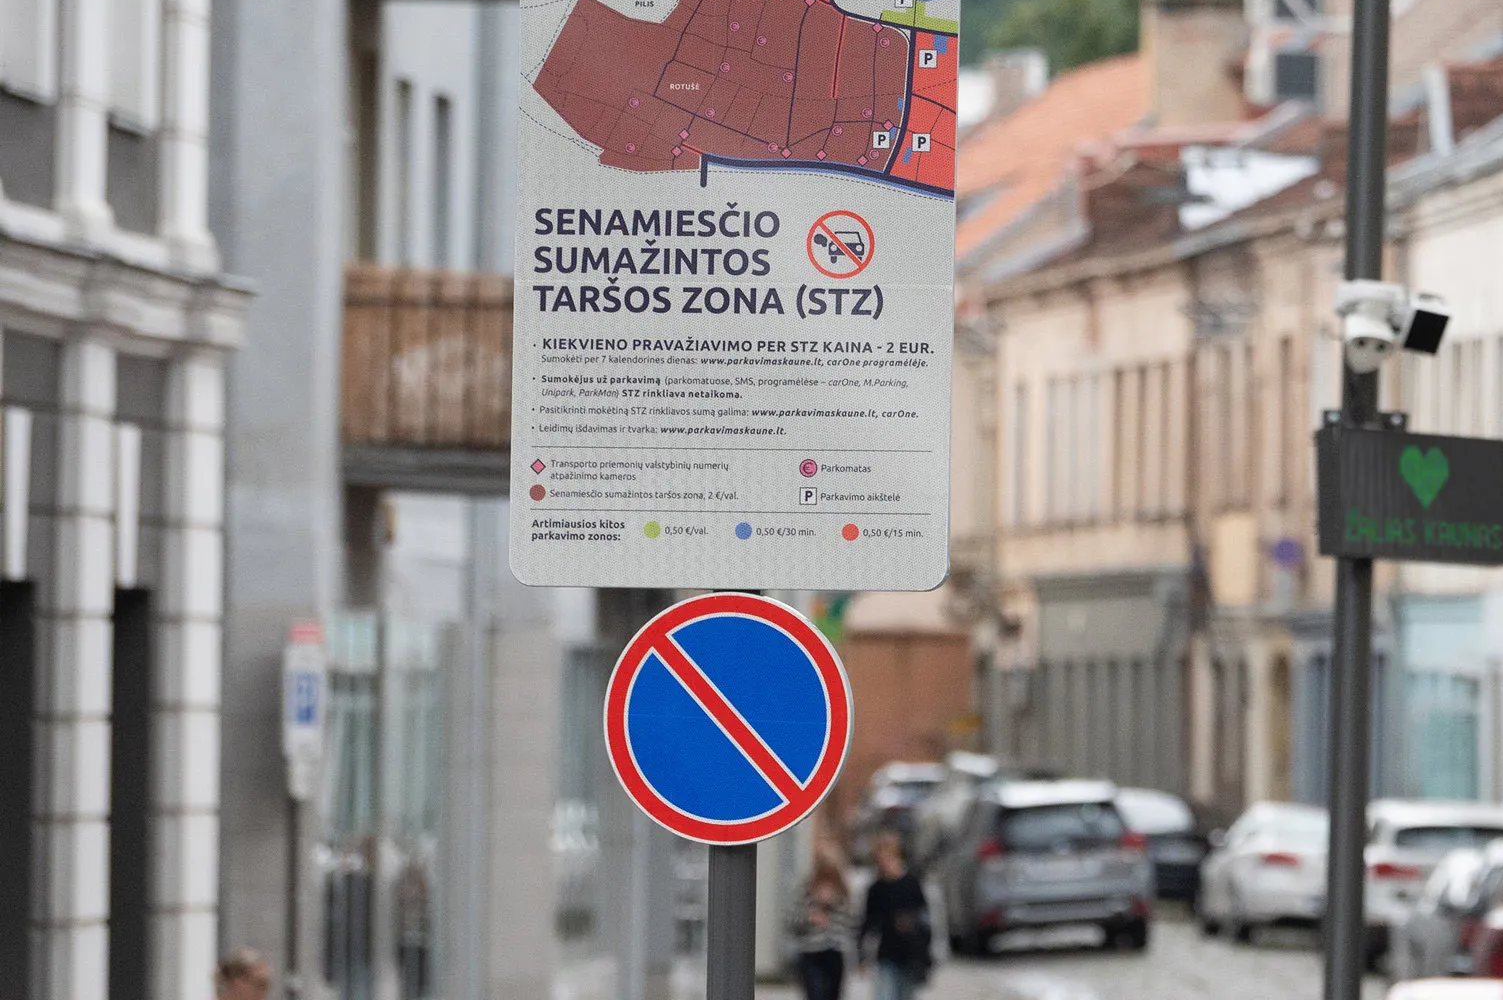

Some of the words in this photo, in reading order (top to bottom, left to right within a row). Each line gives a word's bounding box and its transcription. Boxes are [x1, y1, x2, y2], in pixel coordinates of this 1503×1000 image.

[534, 202, 780, 238] SENAMIESČIO
[533, 239, 771, 277] SUMAŽINTOS
[533, 277, 672, 314] TARŠOS
[681, 286, 785, 315] ZONA
[795, 284, 884, 320] (STZ)
[542, 338, 628, 350] KIEKVIENO
[632, 336, 752, 352] PRAVAŽIAVIMO
[757, 340, 786, 352] PER
[790, 340, 818, 353] STZ
[823, 341, 872, 353] KAINA
[886, 342, 894, 353] 2
[899, 342, 935, 354] EUR.
[541, 354, 583, 363] Sumokėti
[584, 356, 599, 364] per
[602, 355, 607, 363] 7
[608, 355, 665, 364] kalendorines
[666, 356, 698, 365] dienas:
[700, 356, 825, 368] www.parkavimaskaune.lt,
[826, 358, 861, 366] carOne
[862, 358, 929, 368] programėlėje.
[541, 374, 594, 385] Sumokėjus
[596, 374, 608, 384] už
[609, 375, 661, 386] parkavimą
[664, 376, 734, 387] (parkomatuose,
[734, 377, 757, 387] SMS,
[757, 377, 819, 388] programėlėse
[828, 378, 861, 388] carOne,
[578, 388, 619, 397] ParkMan)
[621, 389, 640, 397] STZ
[642, 389, 686, 398] rinkliava
[688, 389, 743, 399] netaikoma.
[539, 405, 586, 414] Pasitikrinti
[588, 406, 629, 416] mokėtiną
[630, 406, 647, 415] STZ
[648, 407, 691, 416] rinkliavos
[692, 409, 716, 417] sumą
[717, 408, 750, 418] galima:
[751, 408, 879, 420] www.parkavimaskaune.lt,
[881, 409, 919, 418] carOne.
[538, 424, 573, 433] Leidimų
[575, 424, 617, 433] išdavimas
[620, 425, 626, 433] ir
[627, 425, 658, 433] tvarka:
[660, 425, 787, 436] www.parkavimaskaune.lt.
[551, 459, 598, 469] Transporto
[599, 461, 643, 470] priemonių
[644, 460, 691, 471] valstybinių
[693, 462, 729, 471] numerių
[821, 464, 872, 473] Parkomatas
[550, 471, 598, 481] atpažinimo
[599, 472, 637, 481] kameros
[550, 489, 603, 498] Senamiesčio
[604, 490, 653, 499] sumažintos
[654, 490, 682, 499] taršos
[707, 491, 713, 500] 2
[715, 491, 739, 501] €/val.
[805, 490, 813, 502] P
[820, 492, 865, 501] Parkavimo
[531, 518, 597, 529] Artimiausios
[599, 519, 625, 529] kitos
[531, 530, 586, 542] parkavimo
[587, 533, 622, 541] zonos:
[664, 525, 684, 535] 0,50
[684, 526, 709, 536] €/val.
[756, 527, 775, 536] 0,50
[776, 527, 797, 537] €/30
[798, 528, 817, 536] min.
[863, 528, 882, 538] 0,50
[883, 528, 903, 539] €/15
[1423, 520, 1503, 550] KAUNAS
